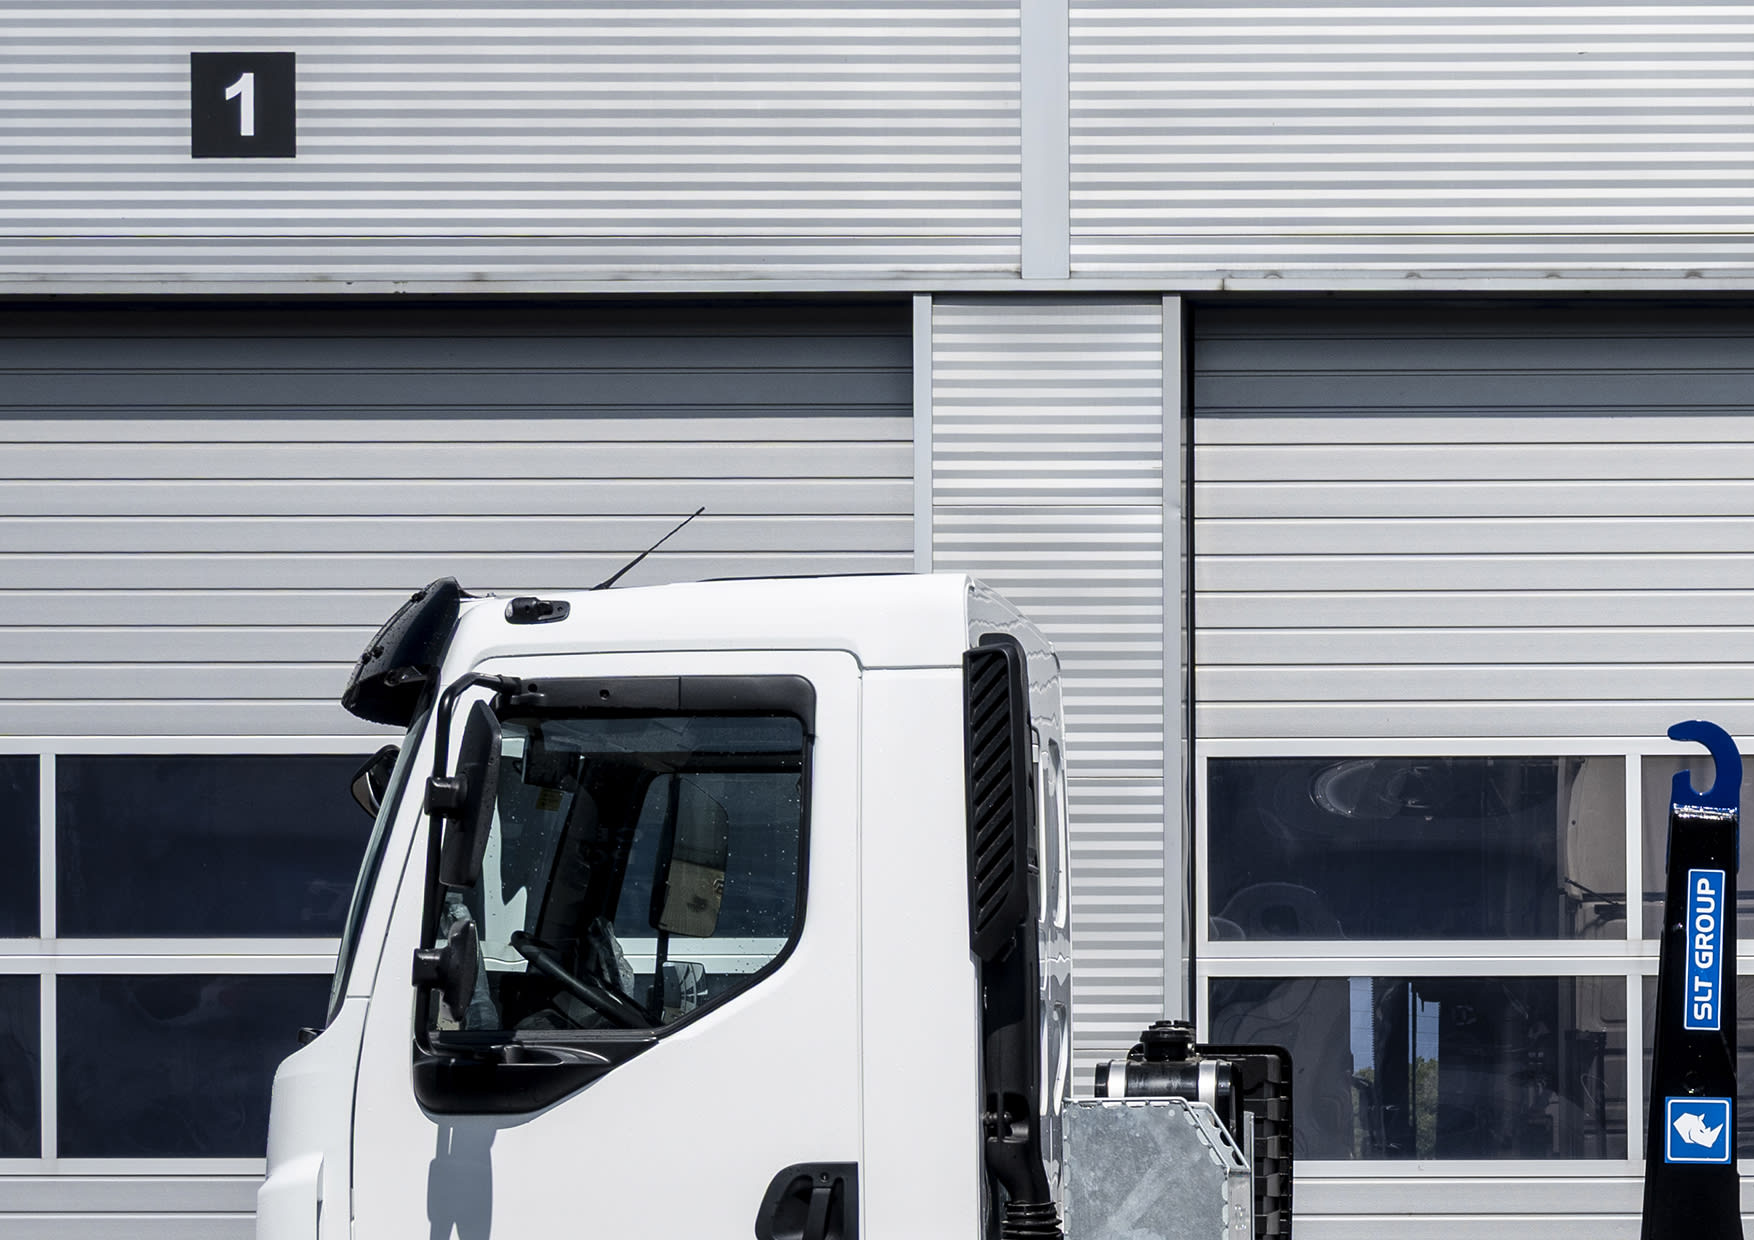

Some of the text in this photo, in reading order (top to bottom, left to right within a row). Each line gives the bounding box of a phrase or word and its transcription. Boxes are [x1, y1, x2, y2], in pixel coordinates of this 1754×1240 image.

[225, 72, 255, 137] 1
[1693, 877, 1716, 1020] SLT GROUP
